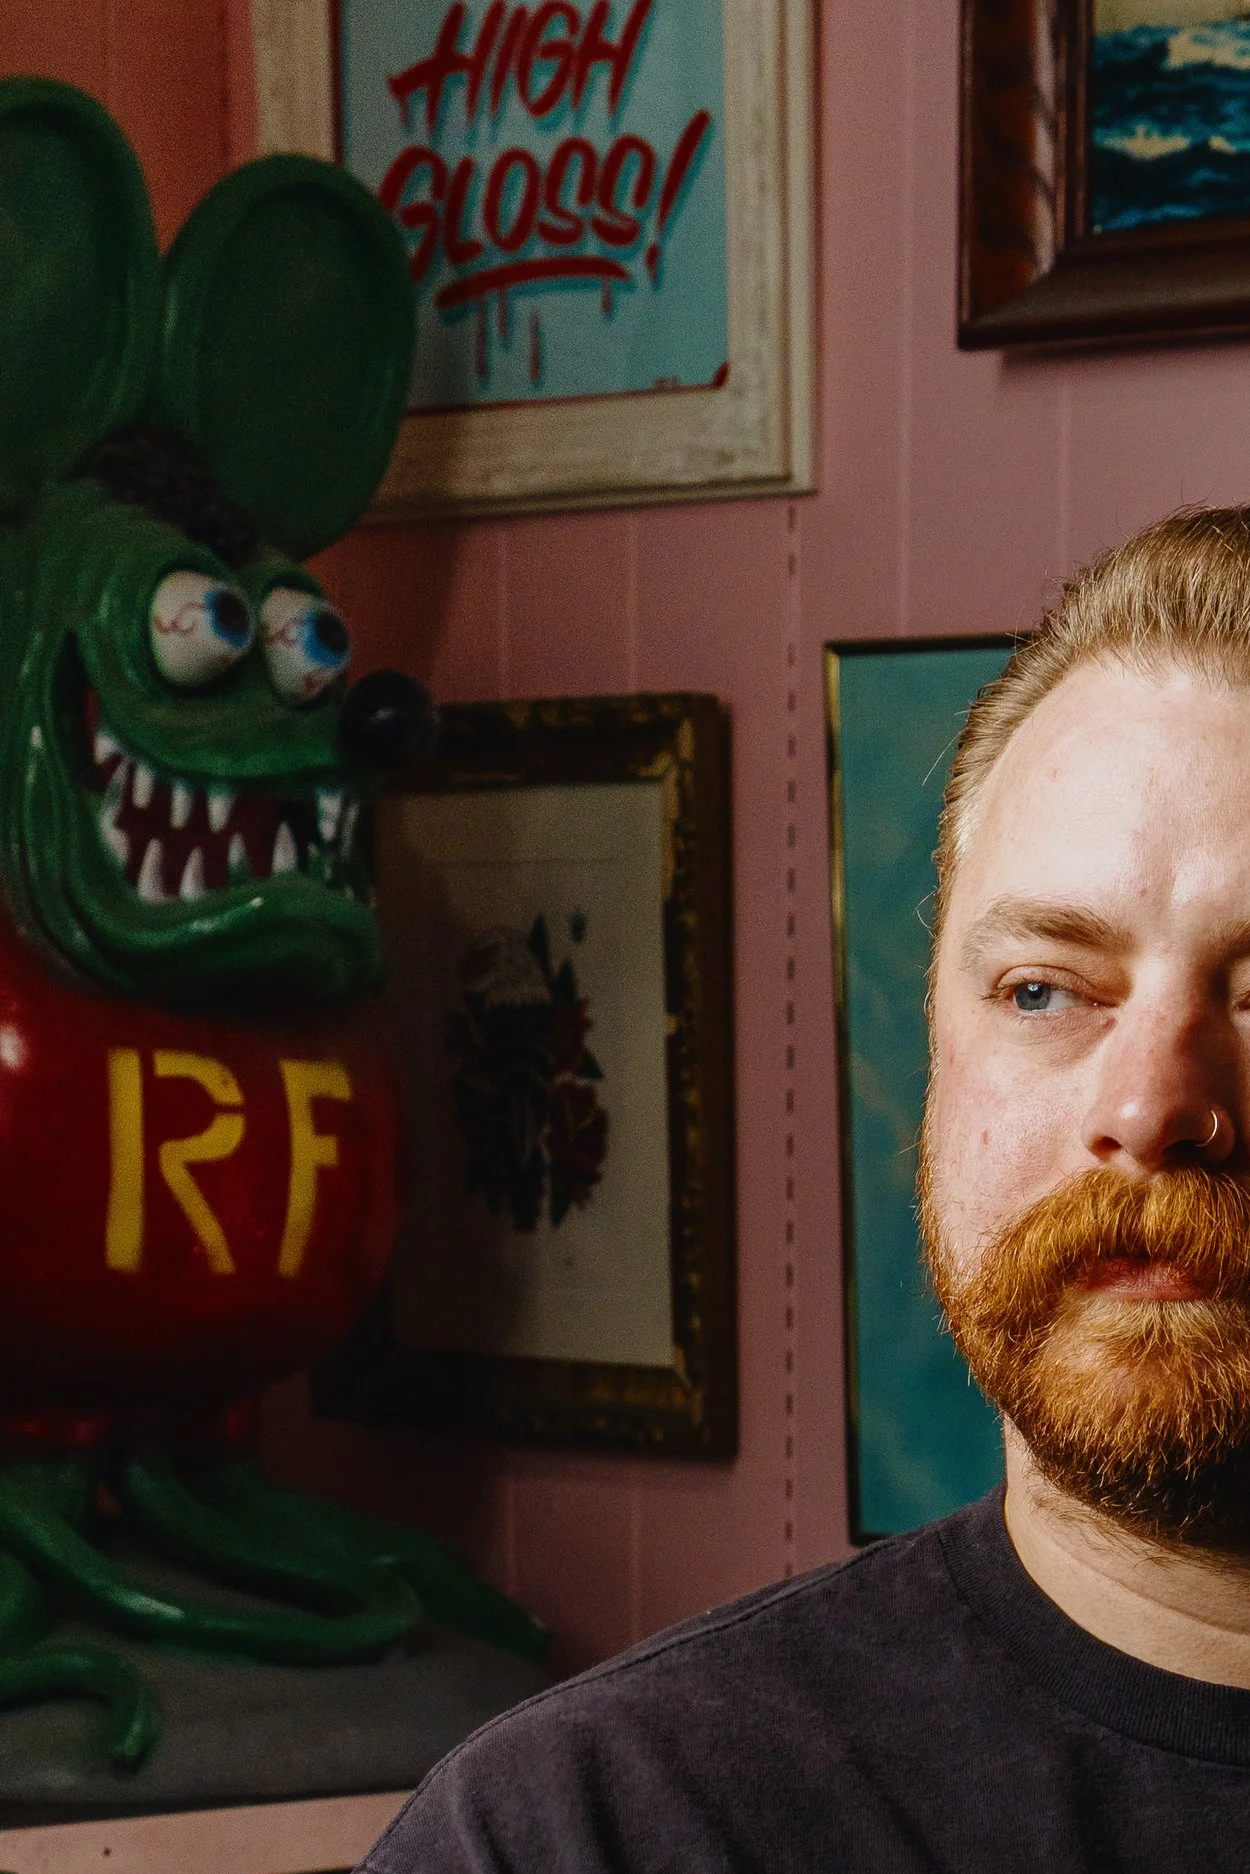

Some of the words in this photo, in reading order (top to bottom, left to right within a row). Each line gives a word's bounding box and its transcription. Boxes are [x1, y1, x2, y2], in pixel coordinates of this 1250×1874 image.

[388, 0, 655, 120] HIGH
[379, 110, 711, 281] GLOSS!
[105, 1046, 351, 1279] RF
